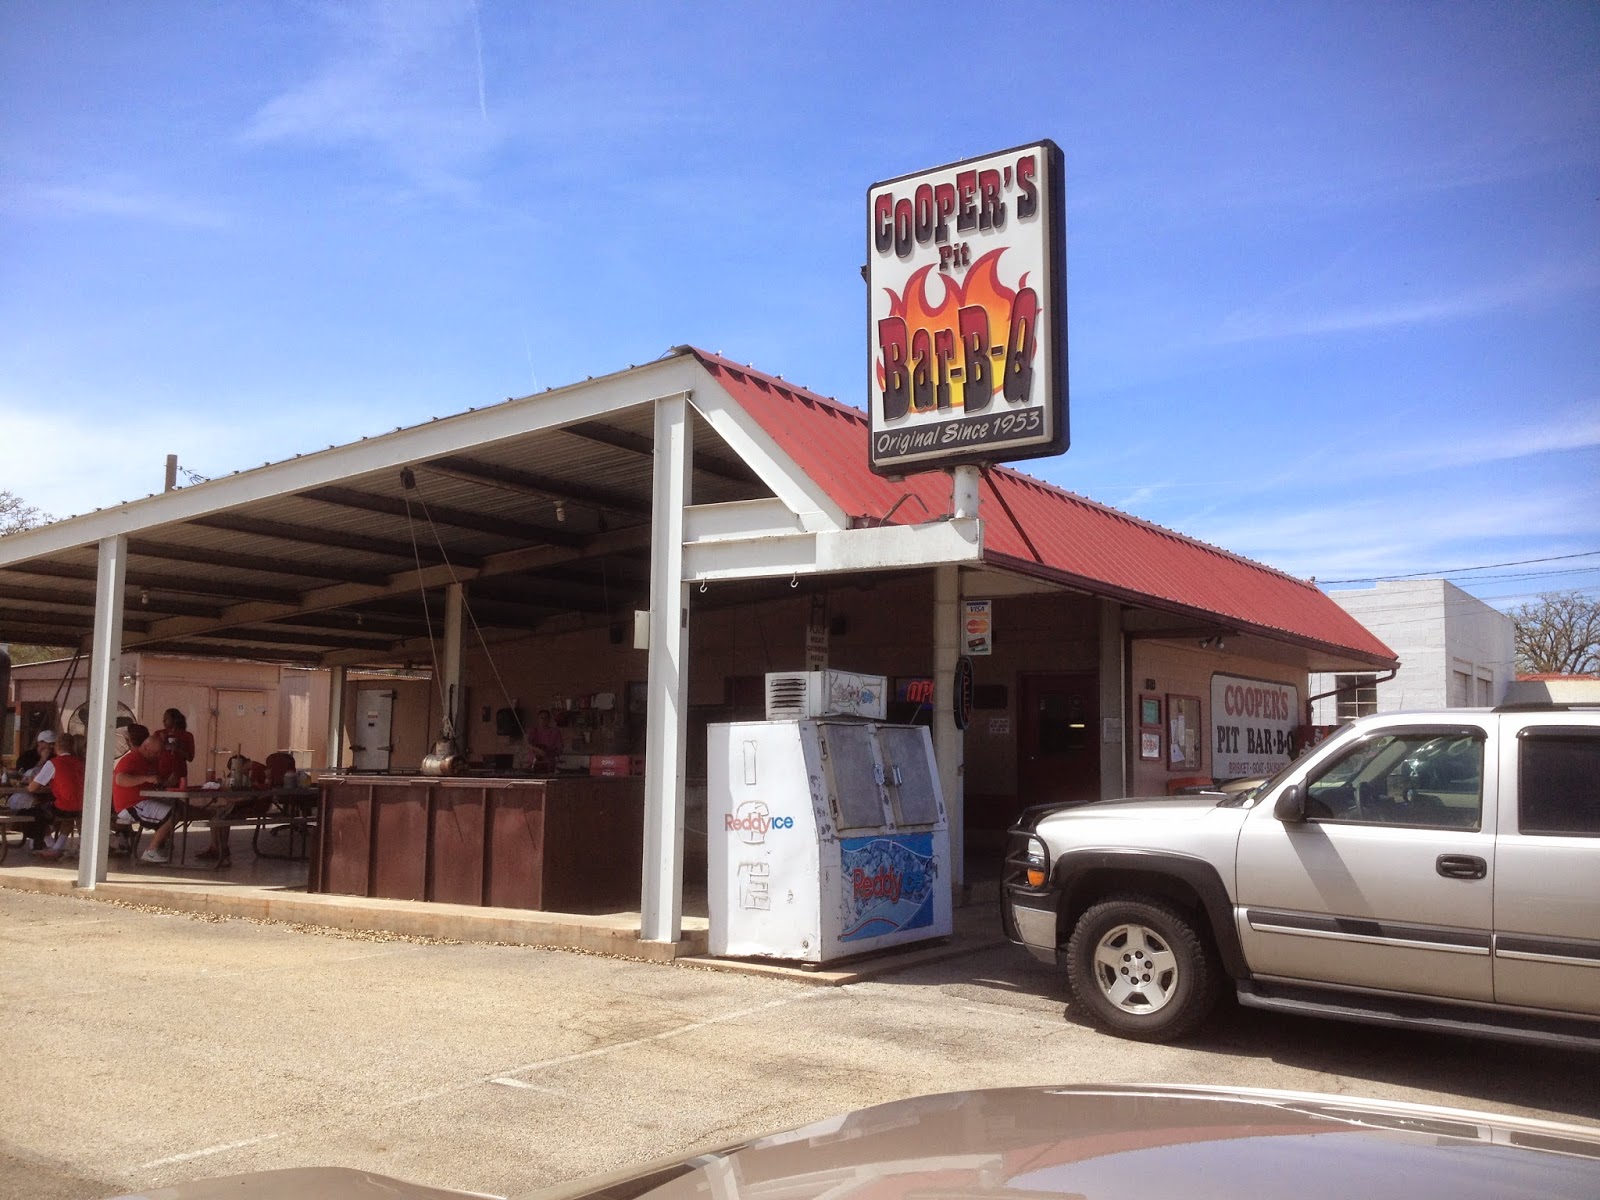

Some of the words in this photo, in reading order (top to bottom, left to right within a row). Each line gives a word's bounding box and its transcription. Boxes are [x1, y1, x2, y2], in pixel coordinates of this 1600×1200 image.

[874, 154, 1037, 258] COOPER'S
[939, 241, 971, 271] Pit
[878, 287, 1039, 422] Bar-B-Q
[878, 421, 940, 454] Original
[941, 422, 988, 444] Since
[993, 411, 1040, 436] 1953
[962, 660, 970, 722] OPEN
[1225, 684, 1288, 720] COOPER'S
[1217, 725, 1239, 754] PIT
